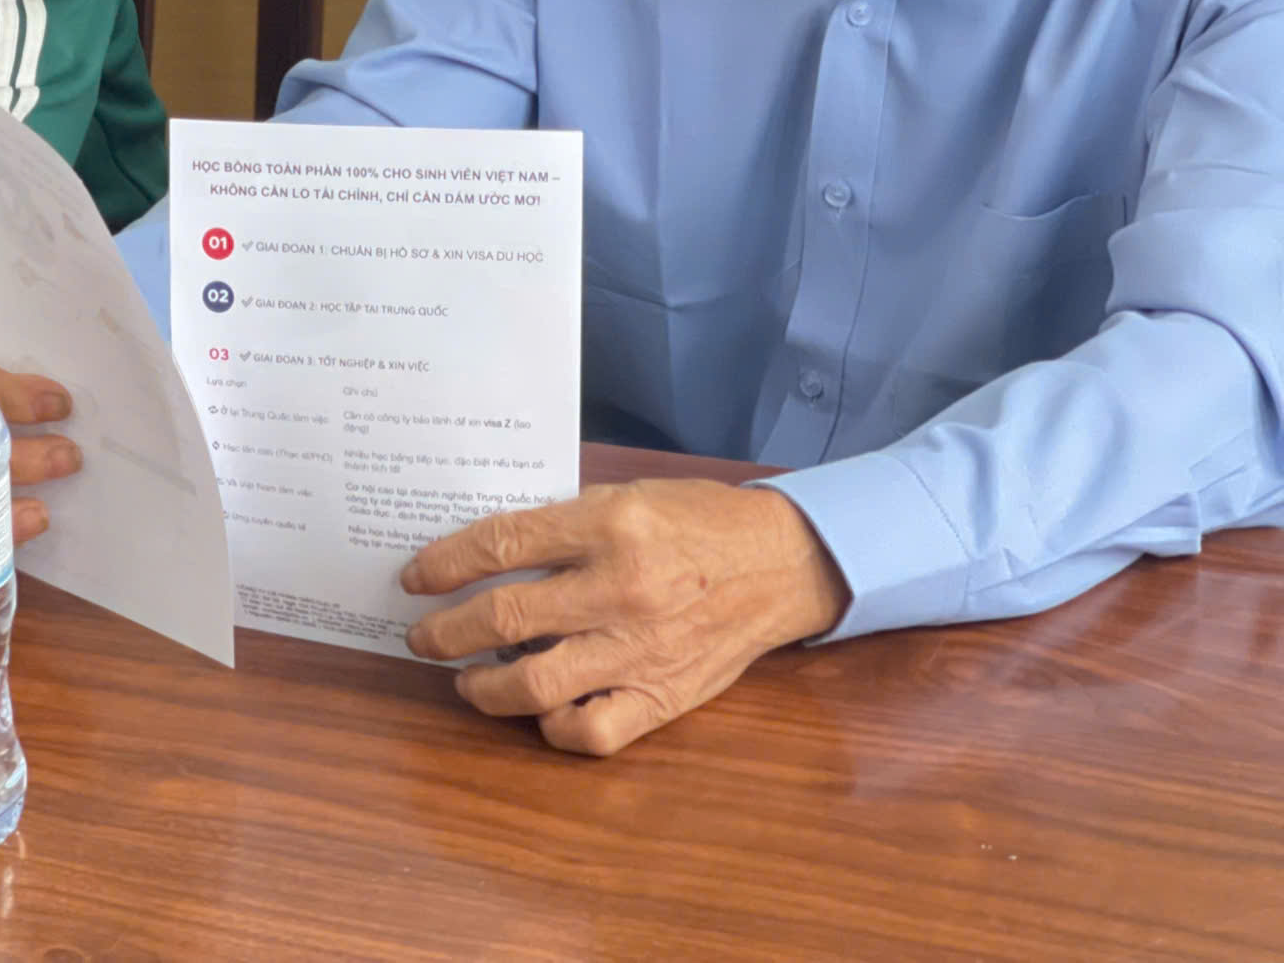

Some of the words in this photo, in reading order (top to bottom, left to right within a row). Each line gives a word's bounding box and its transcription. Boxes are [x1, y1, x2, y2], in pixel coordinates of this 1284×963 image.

[192, 161, 220, 173] HỌC
[346, 167, 379, 178] 100%
[382, 168, 412, 179] CHO
[415, 168, 447, 180] SINH
[451, 167, 481, 180] VIÊN
[519, 171, 548, 182] NAM
[210, 182, 257, 197] KHÔNG
[292, 188, 310, 199] LO
[209, 236, 227, 250] 01
[256, 242, 278, 253] GIAI
[411, 248, 429, 259] SƠ
[432, 249, 439, 259] &
[444, 249, 463, 260] XIN
[466, 250, 494, 261] VISA
[496, 251, 513, 262] DU
[208, 289, 229, 303] 02
[255, 299, 275, 309] GIAI
[381, 304, 416, 316] TRUNG
[209, 347, 229, 361] 03
[253, 353, 273, 363] GIAI
[378, 359, 386, 370] &
[388, 360, 405, 370] XIN
[484, 418, 503, 428] visa
[504, 418, 512, 428] Z
[477, 492, 504, 504] Trung
